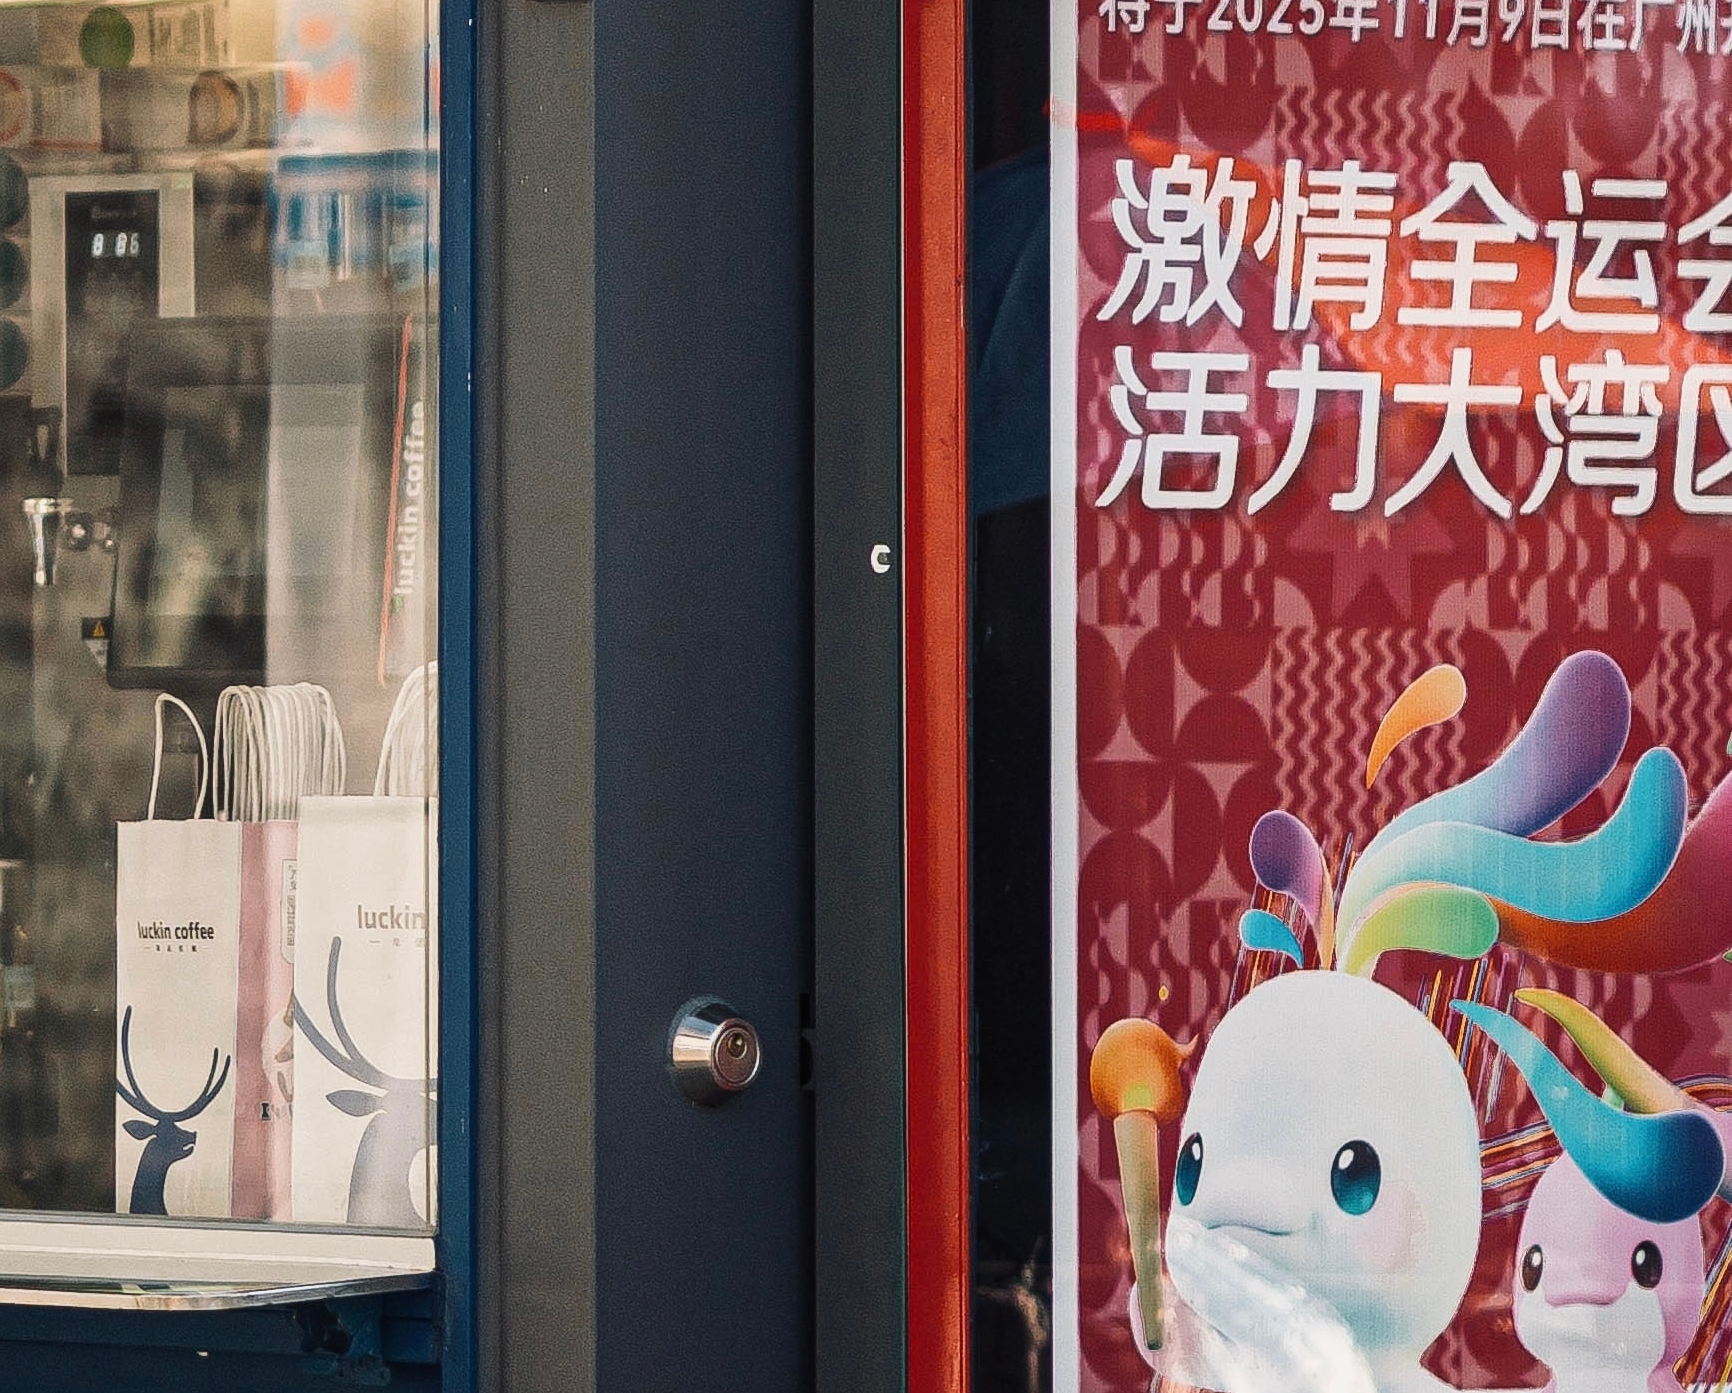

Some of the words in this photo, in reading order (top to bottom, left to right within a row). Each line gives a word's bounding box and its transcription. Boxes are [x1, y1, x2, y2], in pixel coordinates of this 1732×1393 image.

[394, 506, 419, 594] luckin
[137, 921, 171, 939] luckin
[174, 921, 215, 939] coffee
[356, 904, 426, 930] luckin
